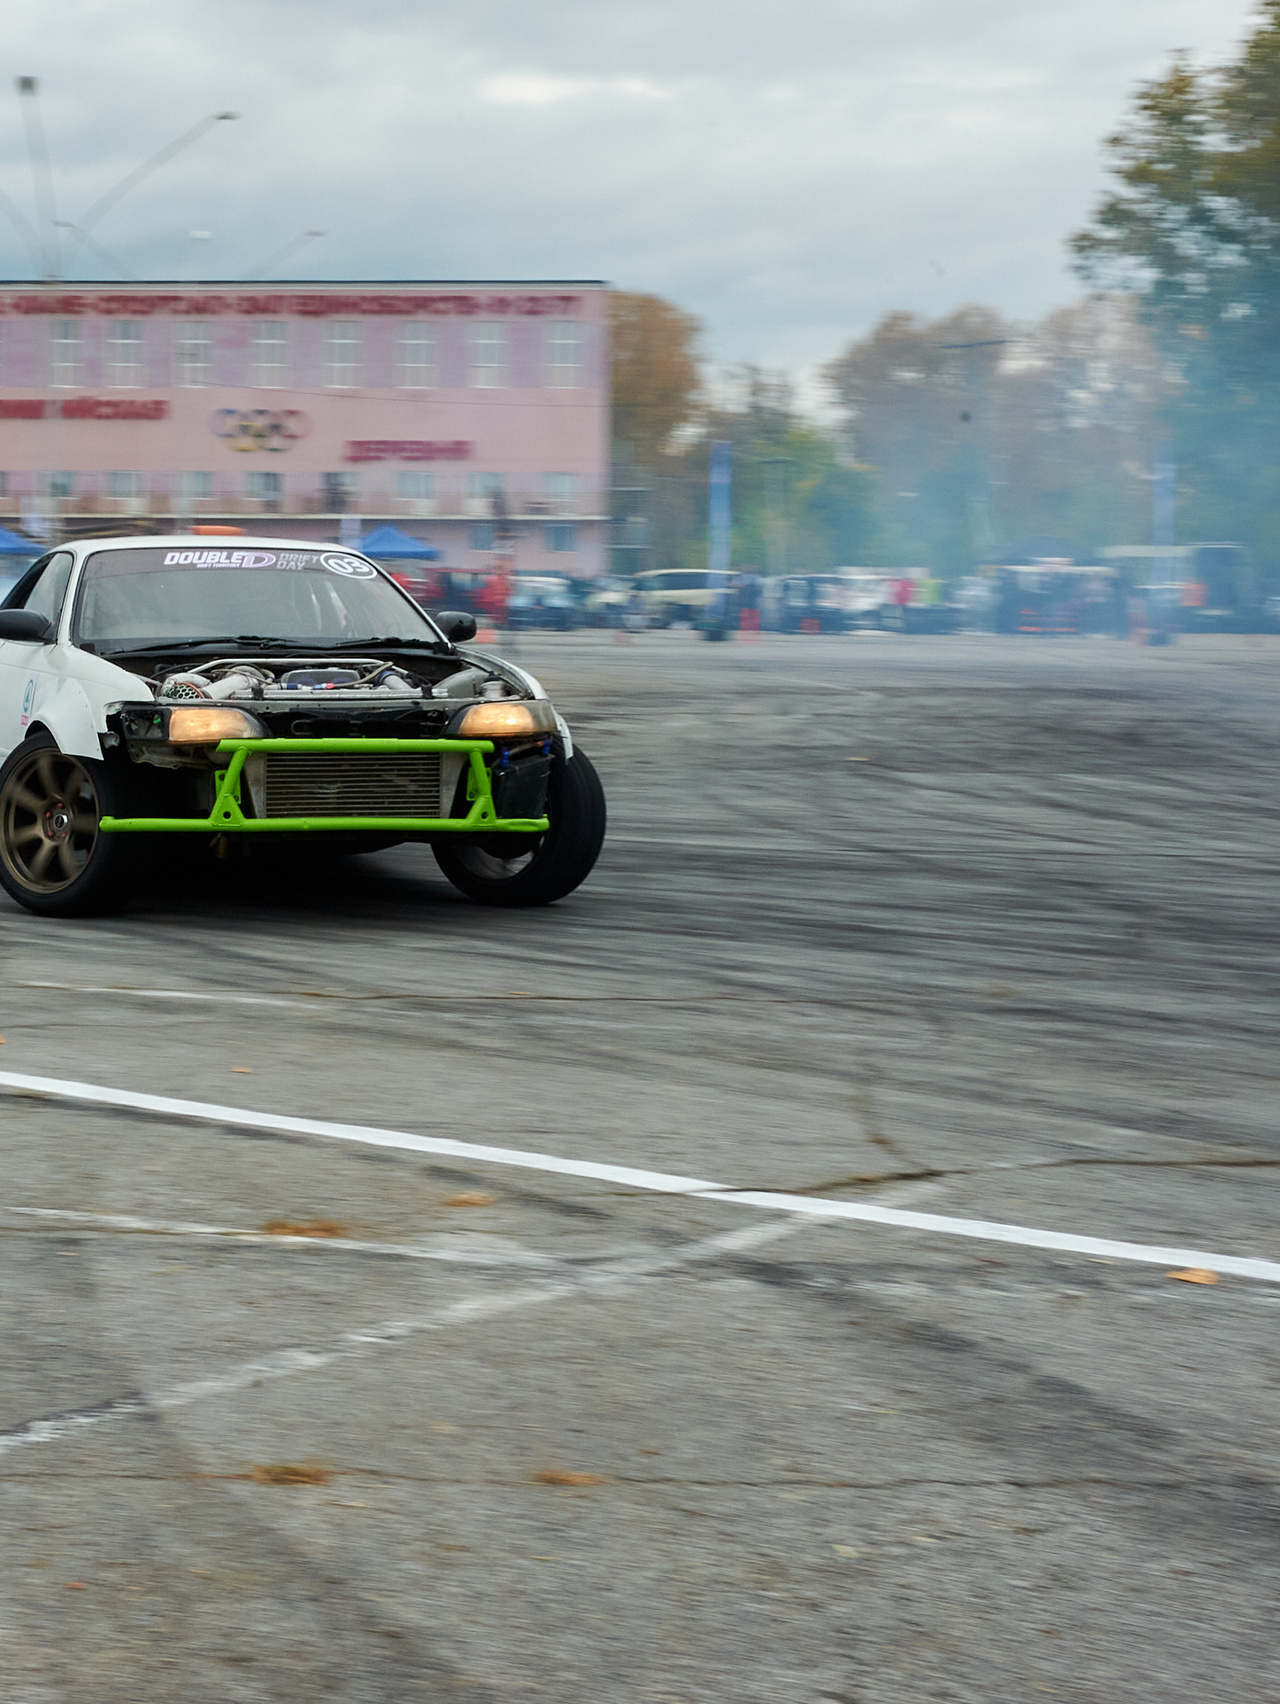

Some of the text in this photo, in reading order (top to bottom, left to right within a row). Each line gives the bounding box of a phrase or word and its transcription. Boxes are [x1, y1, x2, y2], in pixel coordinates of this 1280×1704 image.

[278, 553, 320, 563] DRIFT
[276, 561, 305, 571] DAY
[327, 557, 370, 574] 03
